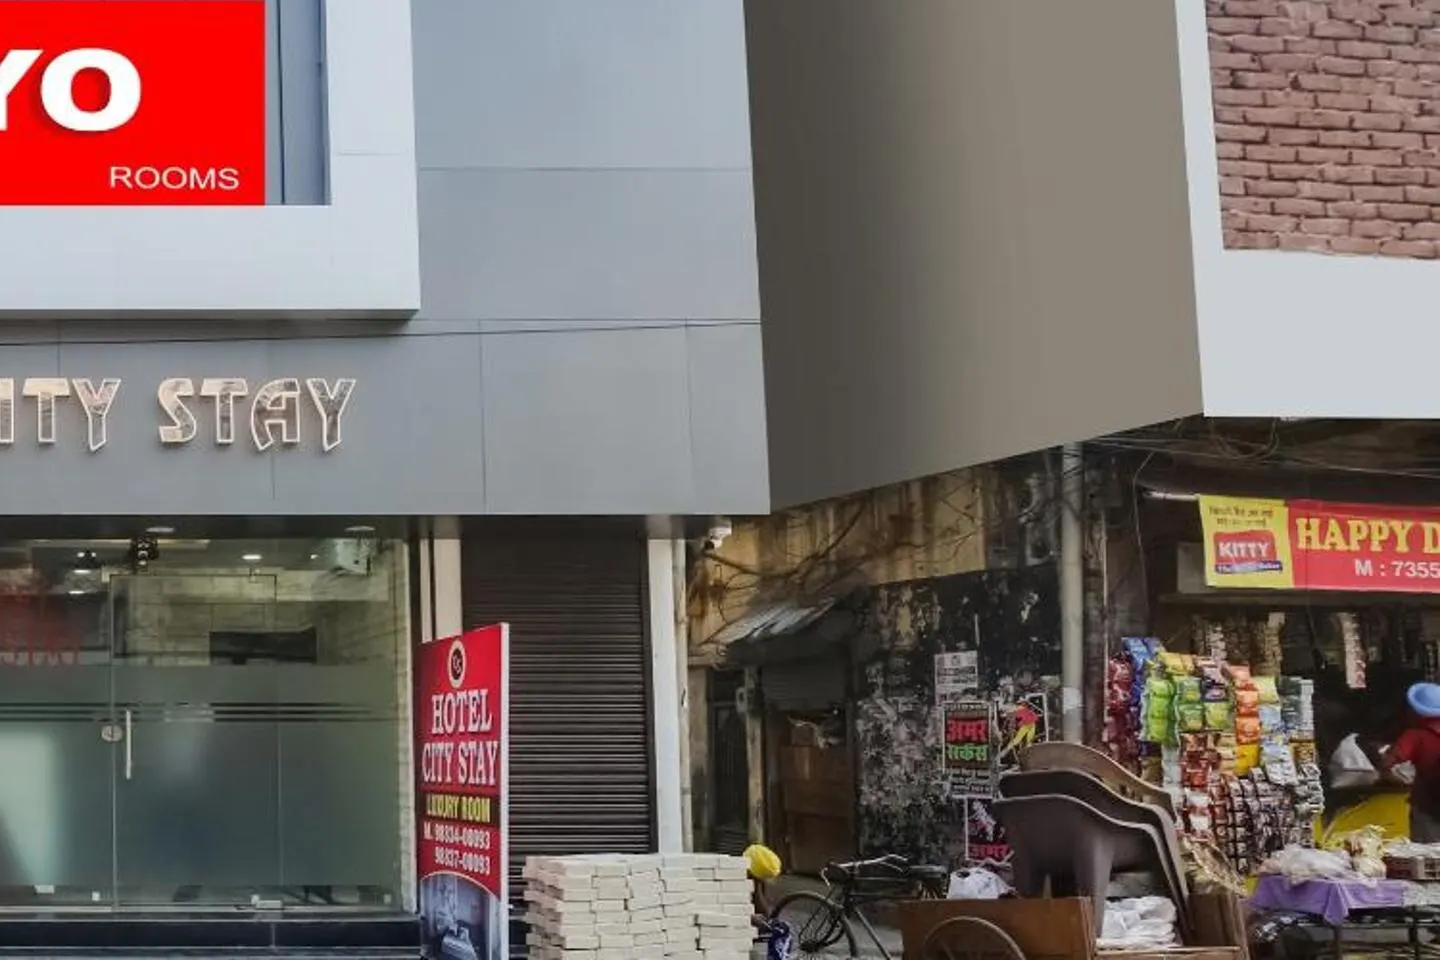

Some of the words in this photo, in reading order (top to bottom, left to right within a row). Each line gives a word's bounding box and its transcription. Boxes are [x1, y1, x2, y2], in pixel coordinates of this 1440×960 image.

[108, 166, 240, 191] ROOMS
[158, 377, 357, 452] STAY
[1219, 542, 1269, 558] KITTY
[1295, 518, 1414, 554] HAPPY
[431, 689, 492, 734] HOTEL
[422, 742, 454, 783] CITY
[458, 741, 498, 785] STAY
